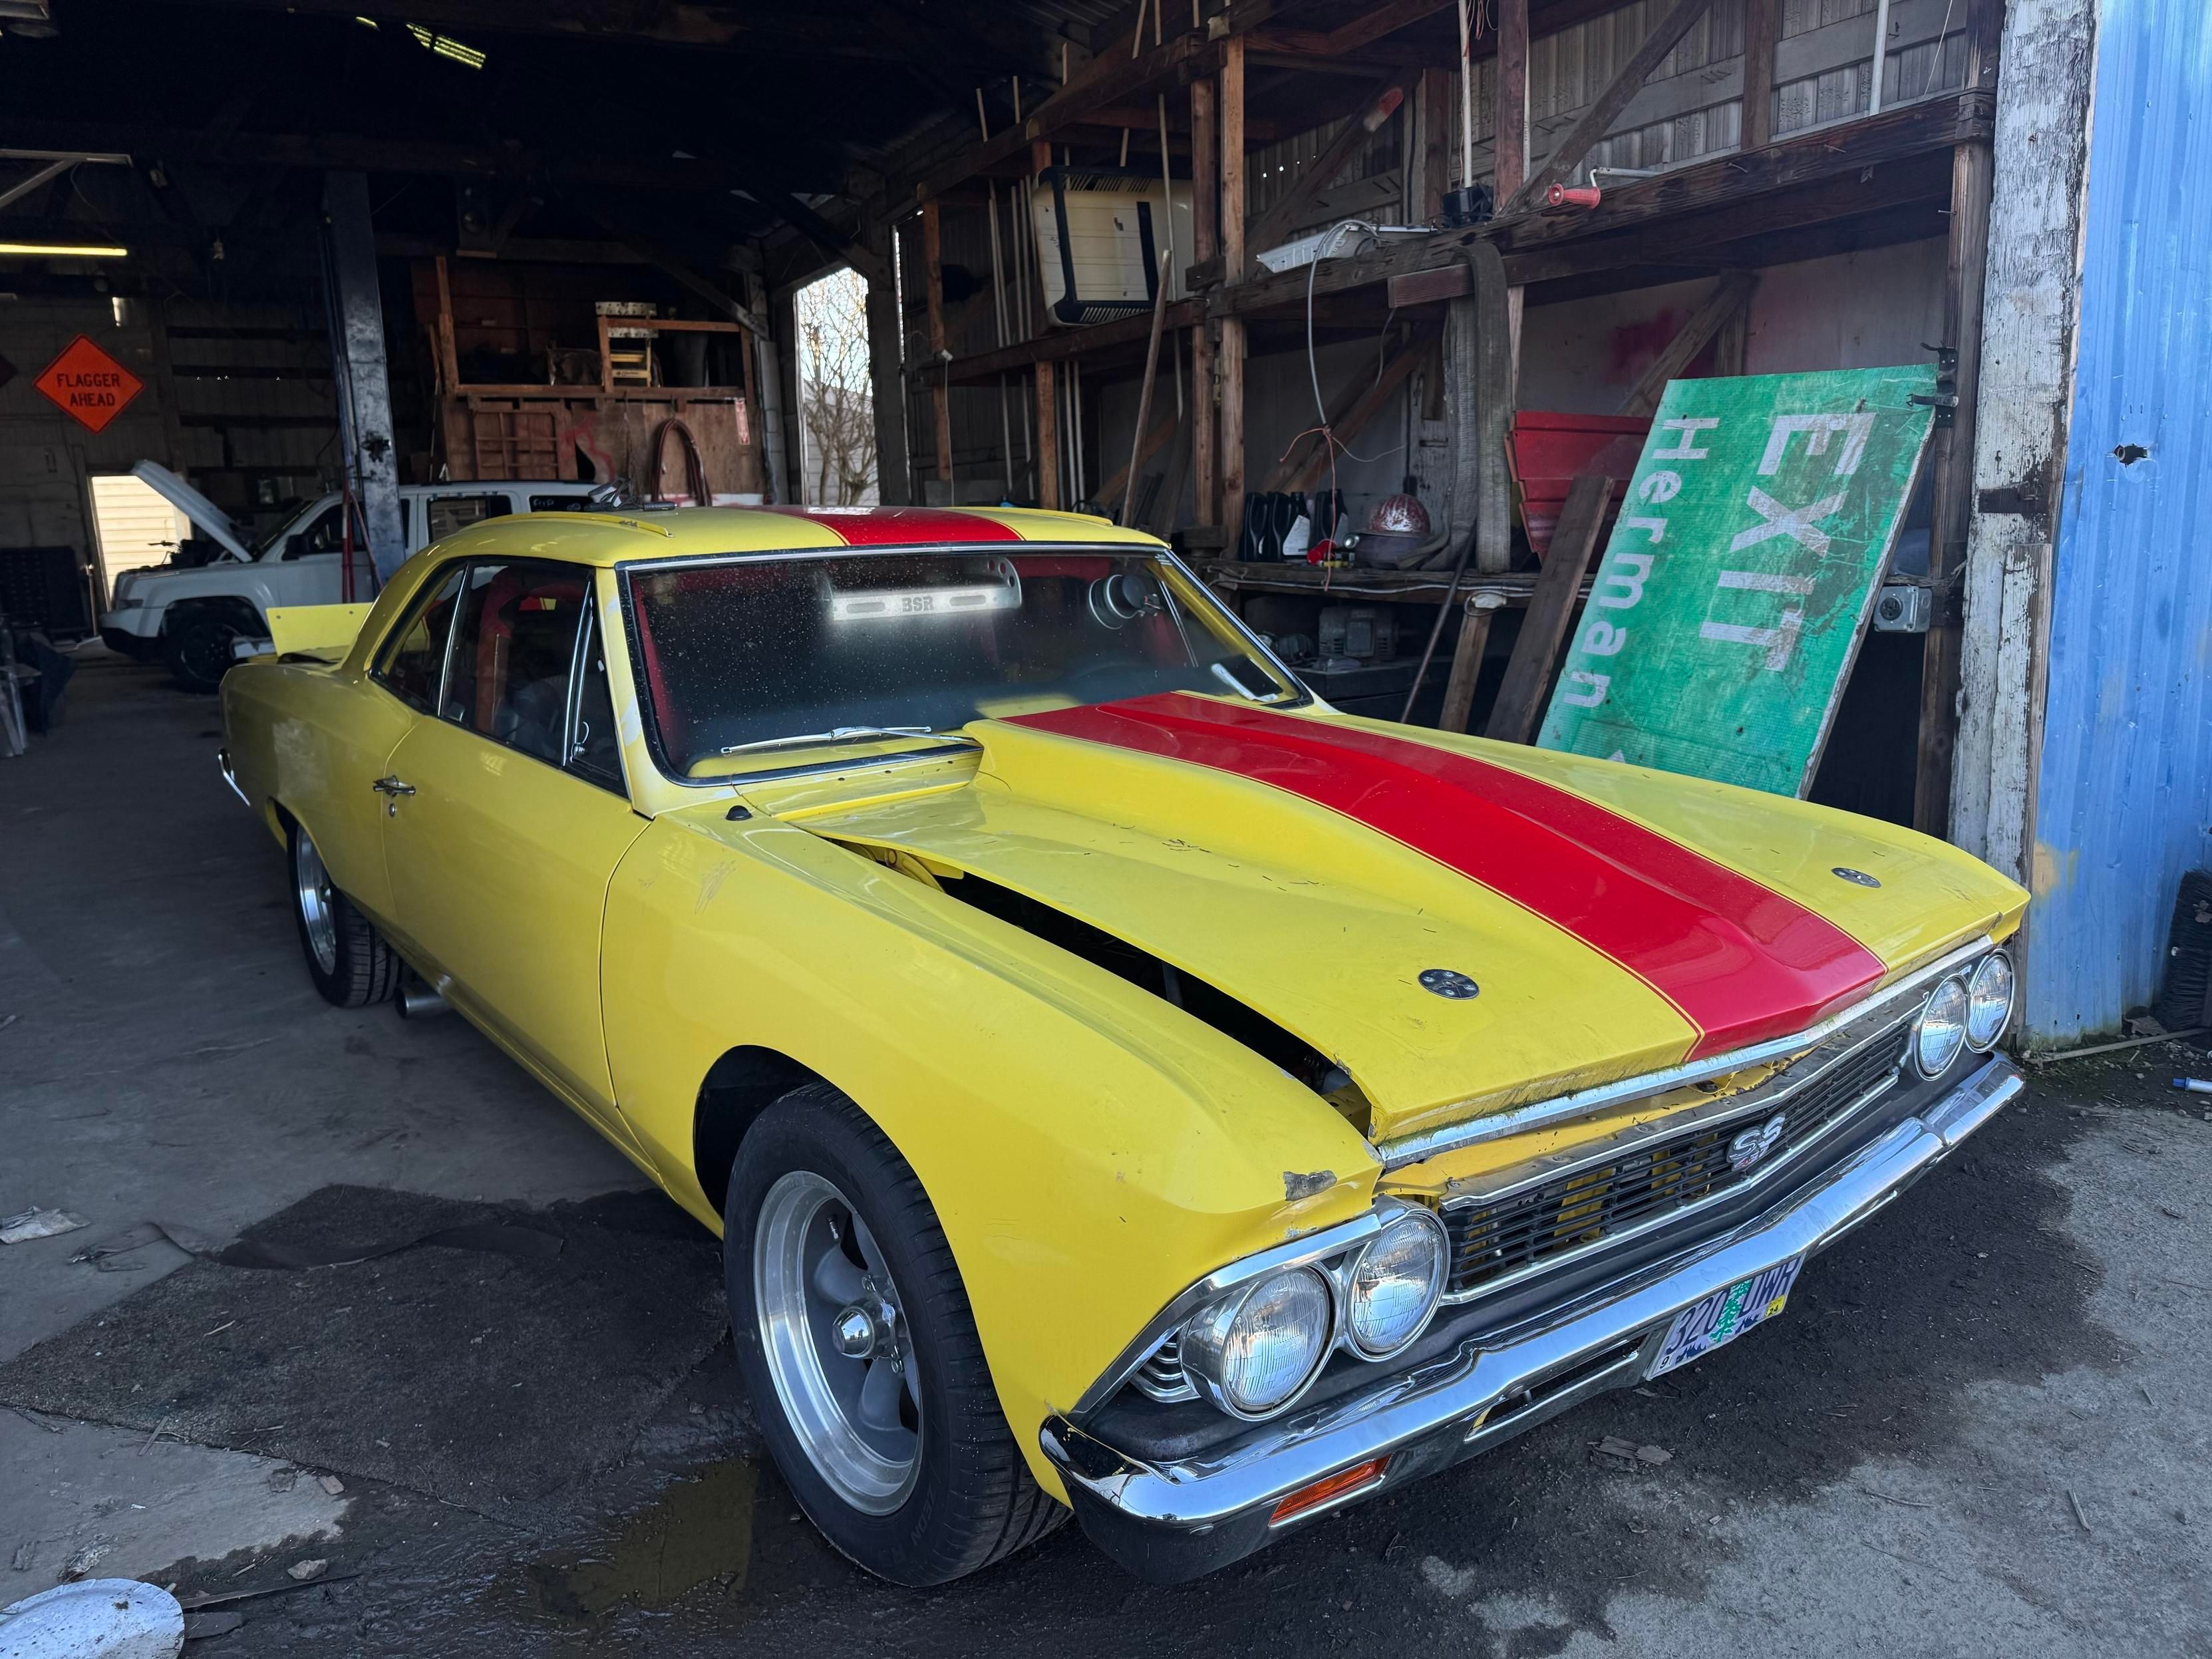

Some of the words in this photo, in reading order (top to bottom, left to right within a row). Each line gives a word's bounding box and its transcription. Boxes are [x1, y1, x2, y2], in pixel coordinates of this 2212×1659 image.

[56, 373, 120, 388] FLAGGER
[69, 392, 116, 408] AHEAD
[1563, 416, 1720, 708] Herman
[1699, 412, 1877, 673] EXIT
[901, 595, 934, 612] BSR
[1729, 1116, 1786, 1161] SS
[1666, 1289, 1730, 1354] 320
[1659, 1355, 1670, 1369] 9
[910, 1484, 937, 1547] ZEON
